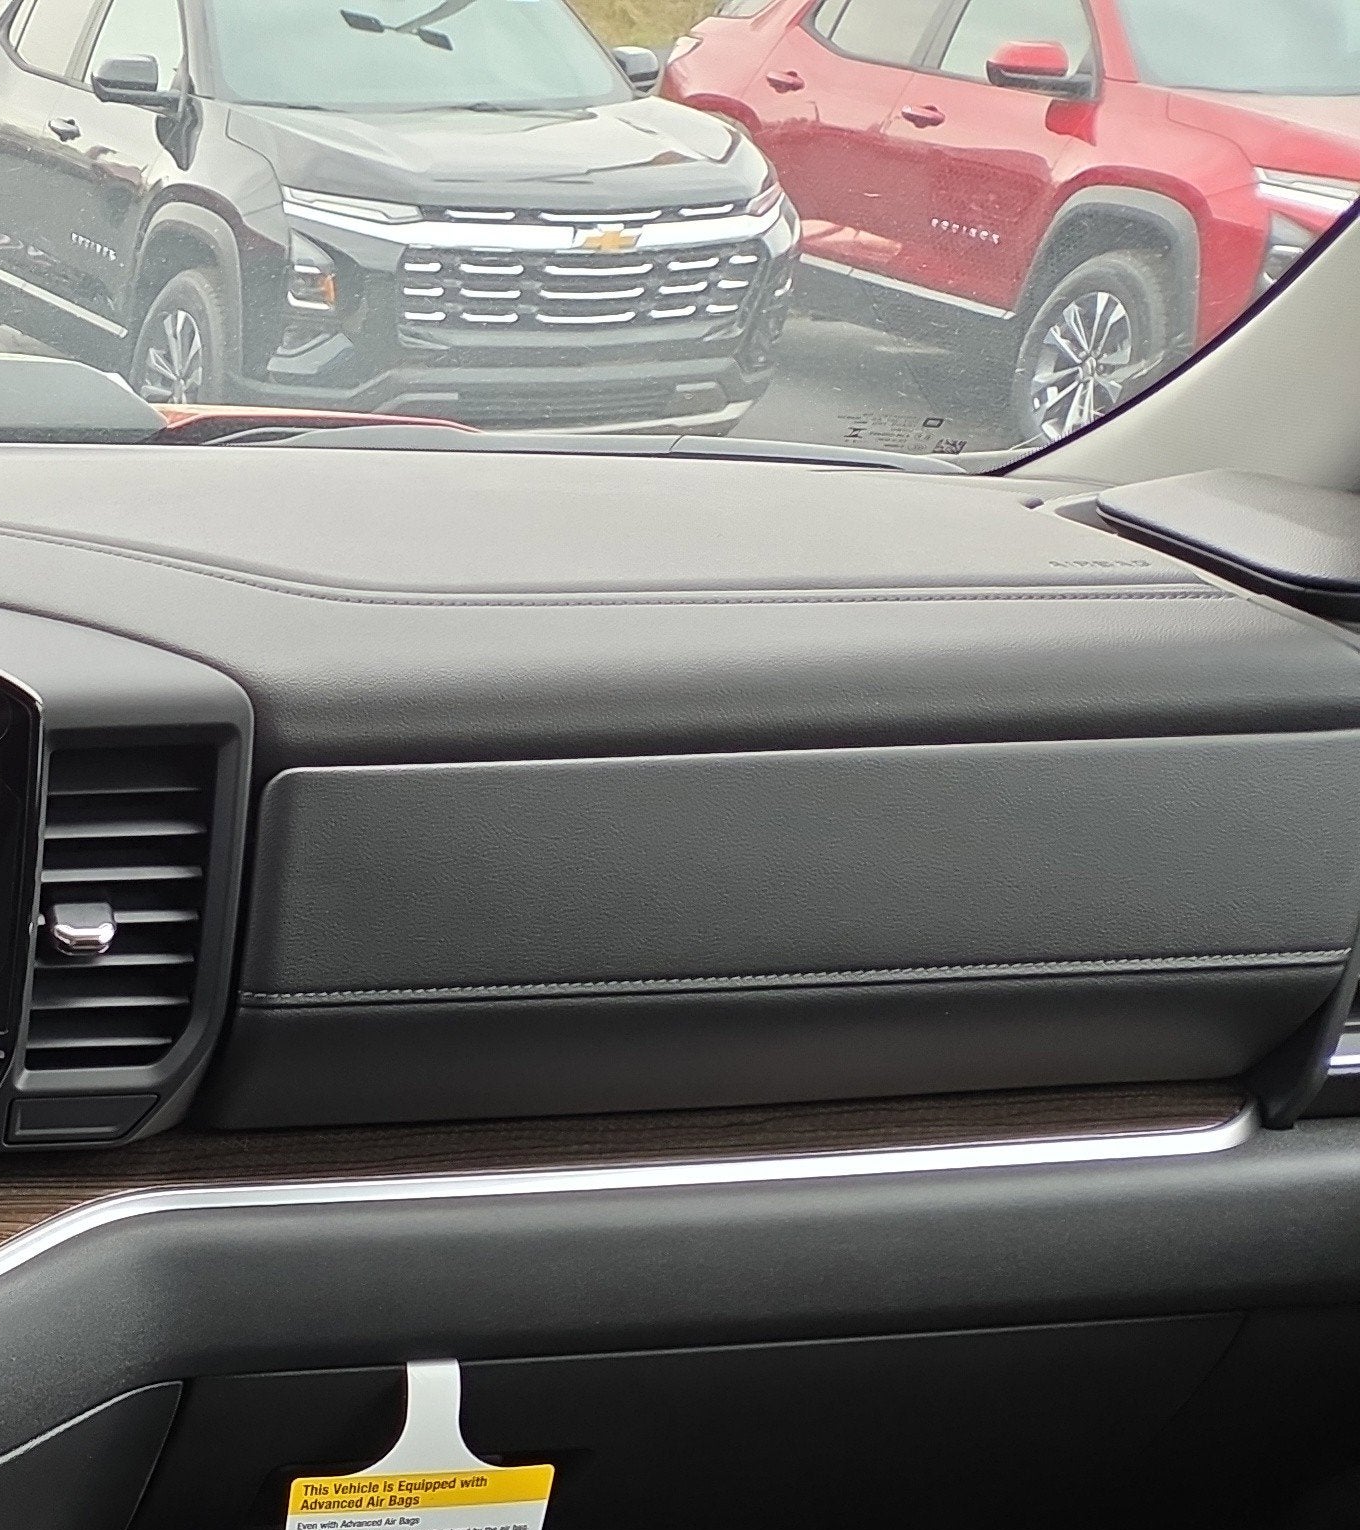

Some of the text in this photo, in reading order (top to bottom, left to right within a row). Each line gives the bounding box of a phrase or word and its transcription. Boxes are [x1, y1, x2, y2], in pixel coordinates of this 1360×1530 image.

[303, 1476, 488, 1497] This Vehicle is Equipped with
[300, 1495, 420, 1511] Advanced Air Bags
[297, 1522, 318, 1530] Even
[320, 1520, 339, 1529] with
[340, 1519, 383, 1528] Advanced
[399, 1517, 420, 1526] Bags
